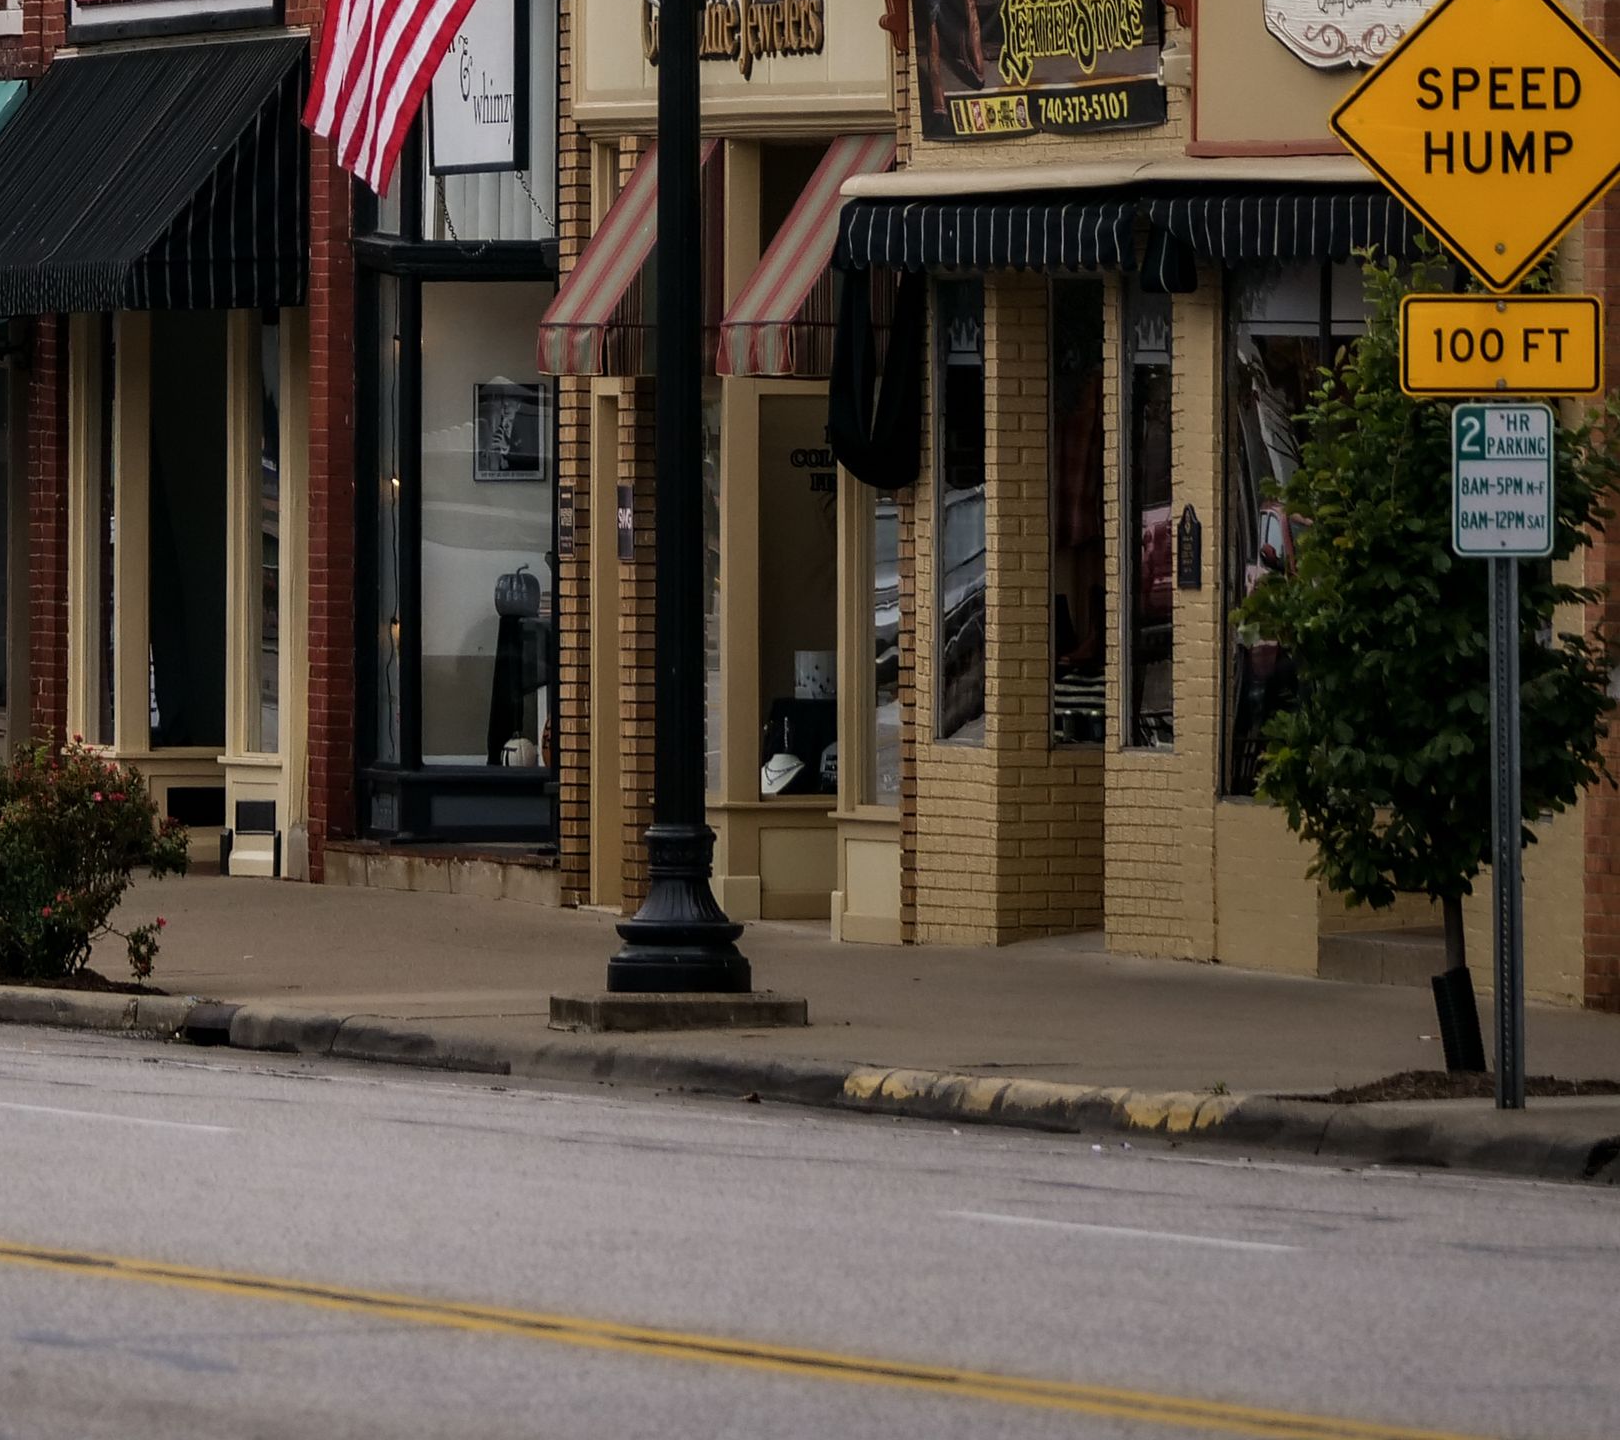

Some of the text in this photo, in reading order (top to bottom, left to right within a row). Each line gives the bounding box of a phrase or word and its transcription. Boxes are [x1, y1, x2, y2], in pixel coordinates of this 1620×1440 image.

[1416, 67, 1582, 111] SPEED
[1038, 91, 1128, 125] 740-373-5101
[1424, 131, 1573, 174] HUMP
[1433, 328, 1570, 363] 100 FT
[1461, 413, 1530, 452] 2 HR
[1487, 437, 1546, 455] PARKING
[1461, 477, 1545, 496] 8AM-5PM M-F
[1461, 511, 1546, 530] 8AM-12PM SAT
